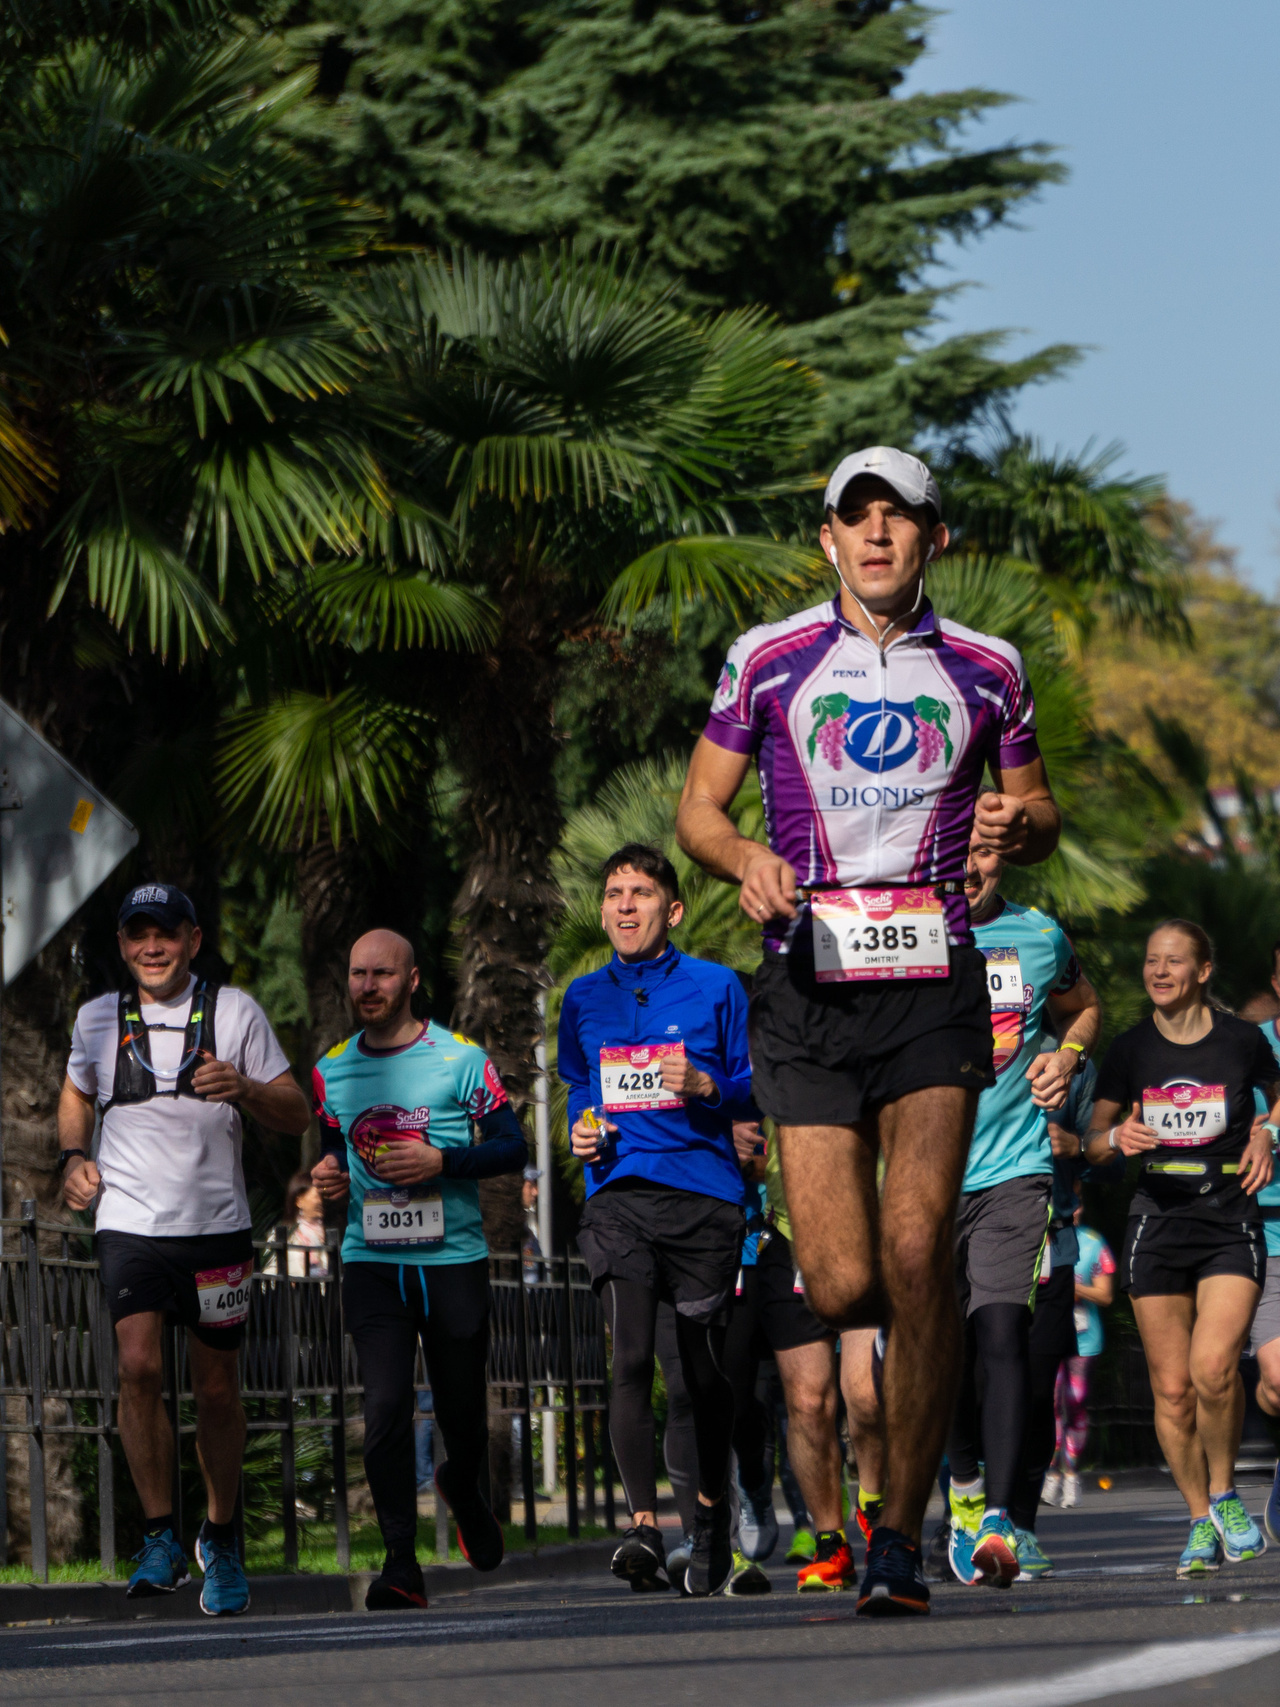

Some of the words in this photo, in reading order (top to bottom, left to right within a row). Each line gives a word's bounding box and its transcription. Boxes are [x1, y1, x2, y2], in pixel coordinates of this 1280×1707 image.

[832, 670, 867, 678] PENZA
[830, 786, 925, 807] DIONIS
[864, 891, 893, 907] Sochi
[843, 925, 918, 952] 4385
[928, 928, 939, 938] 42
[865, 955, 900, 965] DMITRIY
[630, 1048, 650, 1060] Sochi
[604, 1076, 611, 1084] 42
[618, 1071, 664, 1092] 4287
[625, 1092, 660, 1100] АЛЕКСАНДР
[1173, 1089, 1192, 1100] Sochi
[395, 1107, 430, 1125] Sochi
[1161, 1110, 1207, 1130] 4197
[1214, 1111, 1221, 1119] 42
[378, 1209, 424, 1229] 3031
[216, 1285, 250, 1310] 4006
